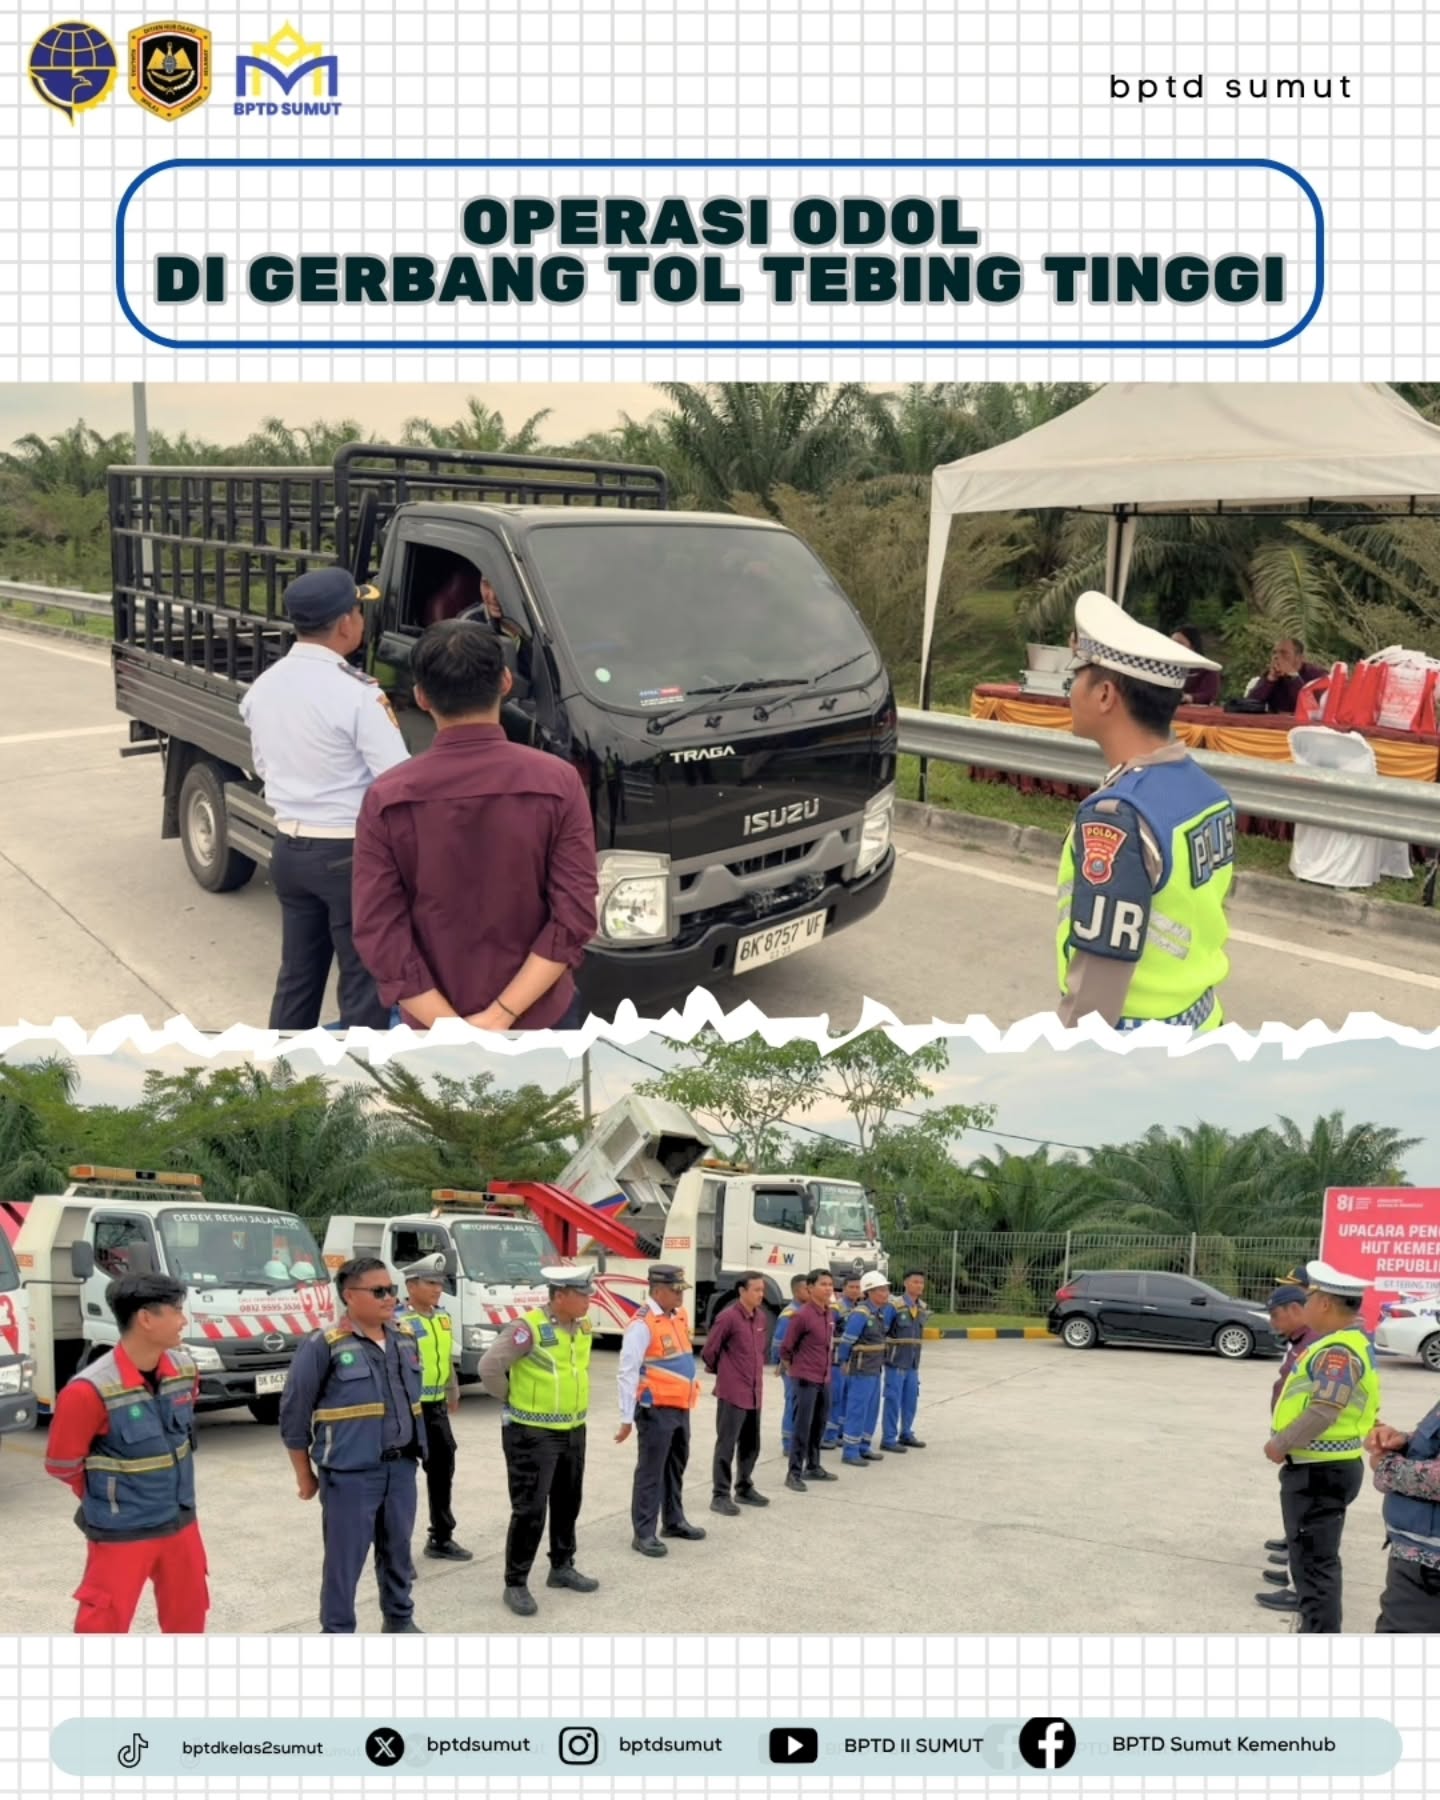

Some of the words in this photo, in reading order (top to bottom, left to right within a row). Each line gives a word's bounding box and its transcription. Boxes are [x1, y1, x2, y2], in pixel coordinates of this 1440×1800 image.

[670, 745, 735, 763] TRAGA
[743, 798, 819, 836] ISUZU
[1086, 826, 1119, 841] POLDA
[1073, 895, 1144, 951] JR
[740, 934, 764, 961] BK
[764, 922, 800, 952] 8757
[173, 1213, 213, 1222] DEREK
[215, 1214, 248, 1223] RESMI
[1338, 1224, 1405, 1238] UPACARA
[1361, 1241, 1391, 1255] HUT
[1376, 1258, 1440, 1273] REPUBLI
